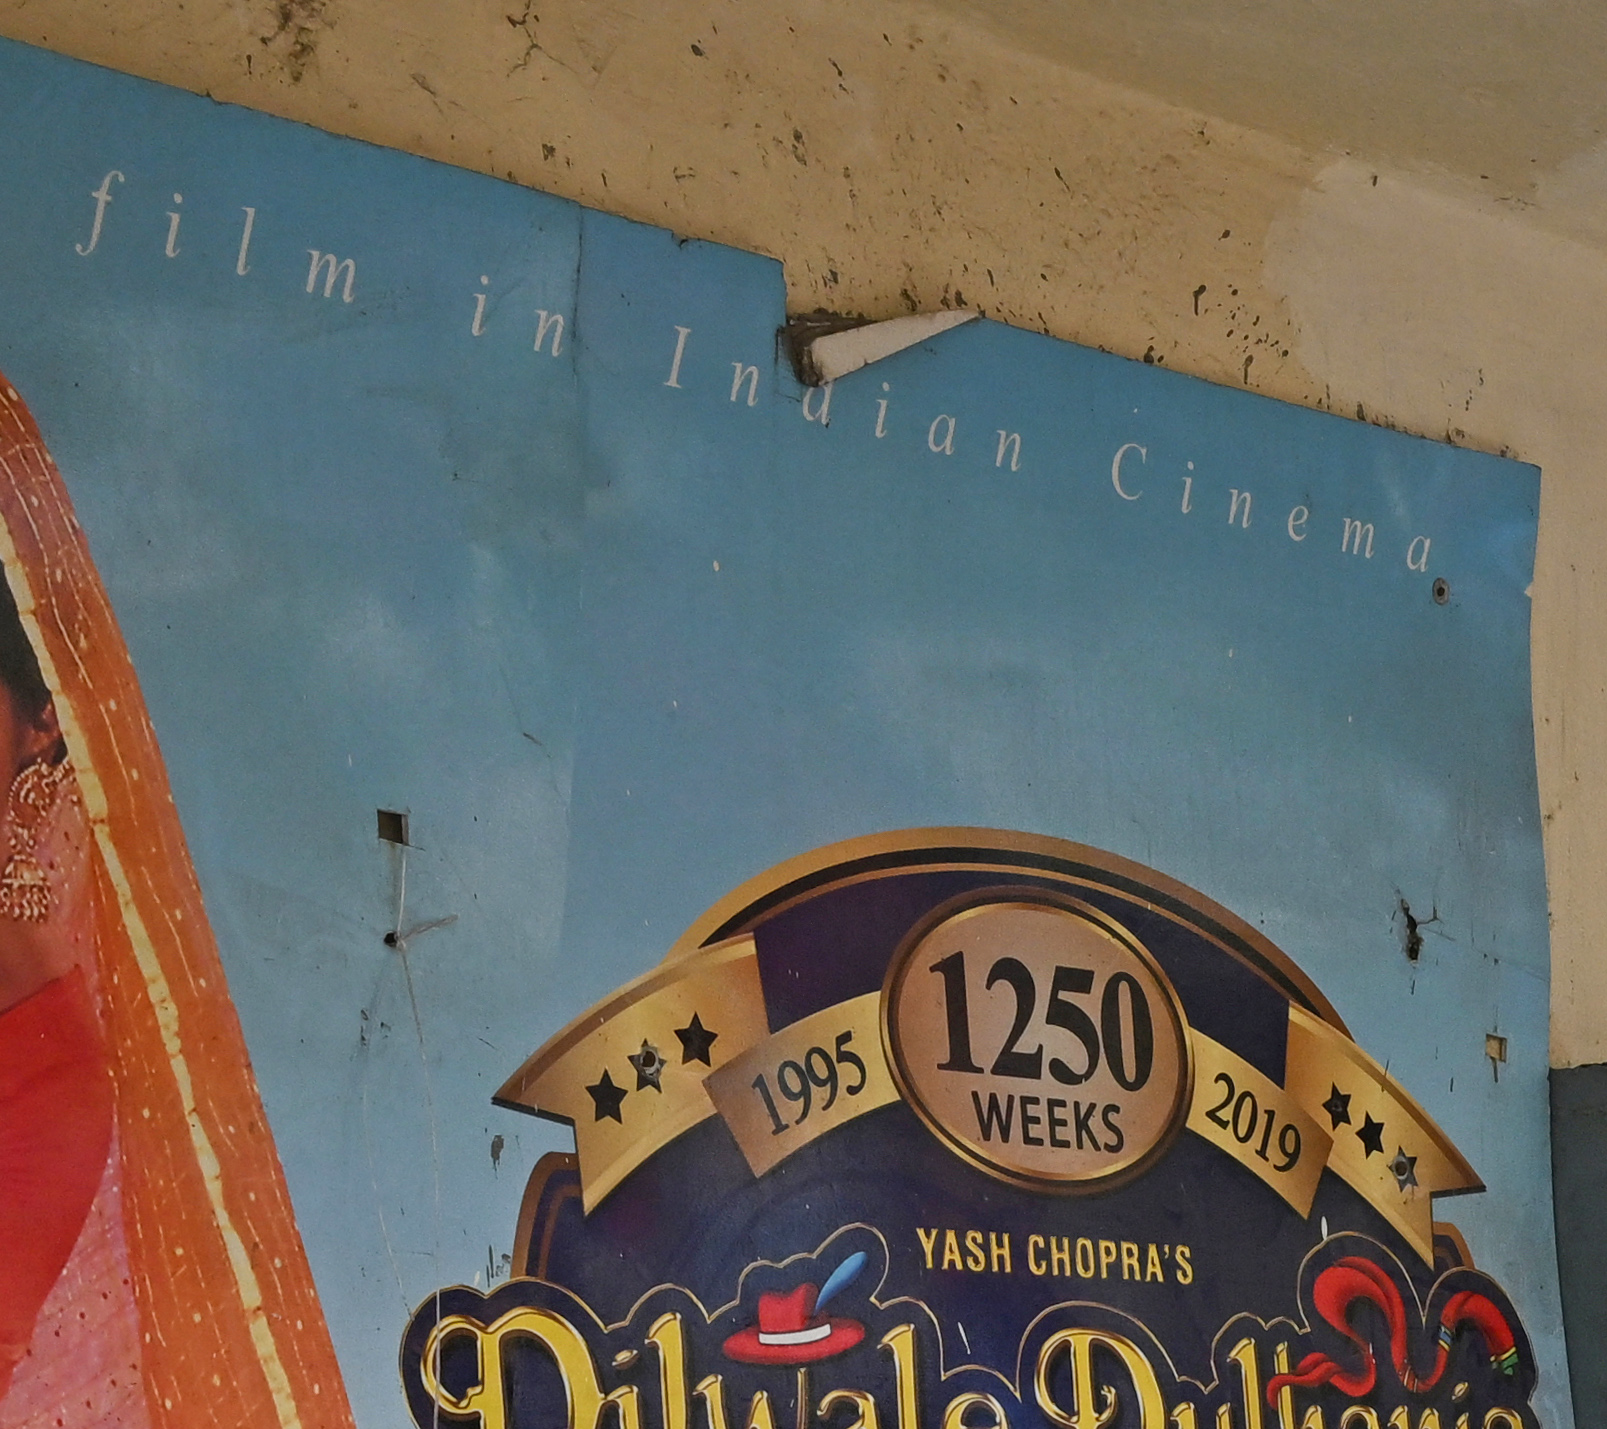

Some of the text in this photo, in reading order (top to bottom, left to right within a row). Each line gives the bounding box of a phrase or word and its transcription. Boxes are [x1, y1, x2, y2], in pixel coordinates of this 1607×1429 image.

[75, 171, 357, 305] film
[470, 275, 568, 358] in
[1110, 441, 1434, 577] Cinema
[933, 948, 1157, 1095] 1250
[749, 1030, 871, 1143] 1995
[970, 1088, 1127, 1157] WEEKS
[1204, 1072, 1305, 1175] 2019
[916, 1227, 1195, 1287] YASH CHOPRA'S
